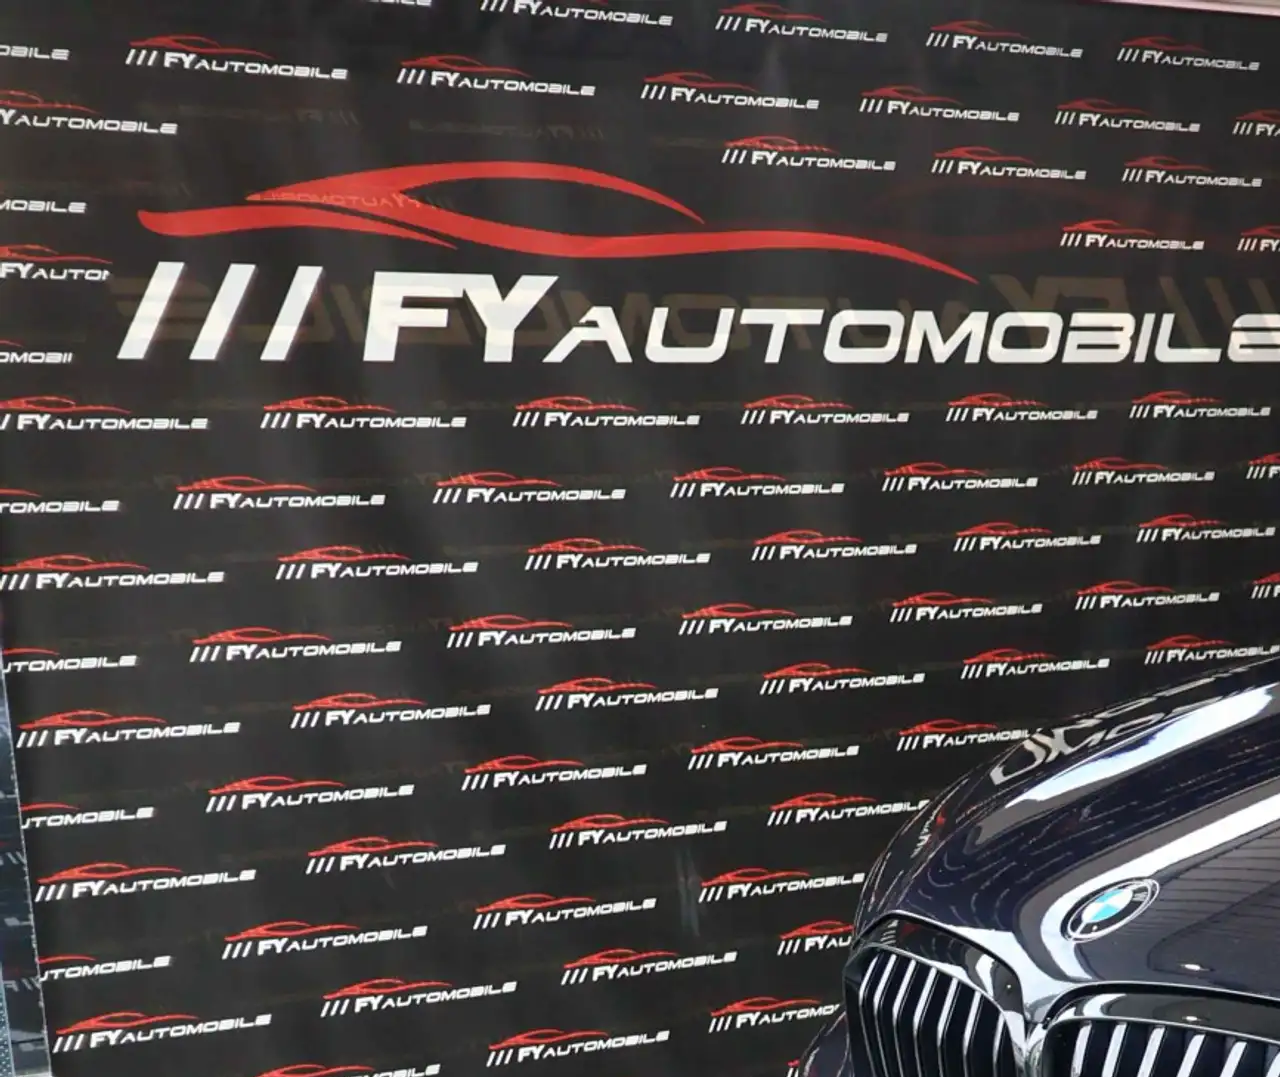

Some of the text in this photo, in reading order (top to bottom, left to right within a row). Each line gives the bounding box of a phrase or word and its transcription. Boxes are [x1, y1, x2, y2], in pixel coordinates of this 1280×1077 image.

[746, 18, 887, 42] FYAUTOMOBILE
[952, 35, 1082, 57] FYAUTOMOBILE
[164, 52, 347, 79] FYAUTOMOBILE
[1142, 50, 1259, 70] FYAUTOMOBILE
[431, 72, 595, 96] FYAUTOMOBILE
[671, 88, 819, 109] FYAUTOMOBILE
[888, 101, 1019, 121] FYAUTOMOBILE
[1079, 114, 1200, 132] FYAUTOMOBILE
[752, 151, 895, 170] FYAUTOMOBILE
[958, 161, 1086, 179] FYAUTOMOBILE
[1146, 170, 1262, 186] FYAUTOMOBILE
[1086, 234, 1204, 250] FYAUTOMOBILE
[545, 412, 699, 426] FYAUTOMOBILE
[770, 410, 908, 424] FYAUTOMOBILE
[972, 408, 1098, 421] FYAUTOMOBILE
[1154, 405, 1270, 418] FYAUTOMOBILE
[18, 414, 208, 430] FYAUTOMOBILE
[296, 414, 466, 428] FYAUTOMOBILE
[908, 477, 1038, 490] FYAUTOMOBILE
[1095, 472, 1214, 484] FYAUTOMOBILE
[467, 488, 625, 502] FYAUTOMOBILE
[700, 483, 844, 496] FYAUTOMOBILE
[210, 494, 385, 508] FYAUTOMOBILE
[980, 536, 1100, 550] FYAUTOMOBILE
[1162, 527, 1275, 541] FYAUTOMOBILE
[780, 544, 916, 559] FYAUTOMOBILE
[311, 562, 478, 578] FYAUTOMOBILE
[557, 554, 710, 568] FYAUTOMOBILE
[36, 572, 224, 588] FYAUTOMOBILE
[1100, 593, 1219, 608] FYAUTOMOBILE
[916, 604, 1042, 620] FYAUTOMOBILE
[709, 616, 852, 633] FYAUTOMOBILE
[478, 628, 636, 646] FYAUTOMOBILE
[226, 642, 401, 660] FYAUTOMOBILE
[1167, 645, 1280, 662] FYAUTOMOBILE
[986, 659, 1110, 676] FYAUTOMOBILE
[789, 674, 924, 692] FYAUTOMOBILE
[568, 688, 718, 708] FYAUTOMOBILE
[326, 705, 490, 726] FYAUTOMOBILE
[55, 722, 240, 745] FYAUTOMOBILE
[718, 746, 859, 767] FYAUTOMOBILE
[494, 764, 646, 787] FYAUTOMOBILE
[242, 785, 414, 809] FYAUTOMOBILE
[578, 821, 727, 845] FYAUTOMOBILE
[340, 845, 506, 870] FYAUTOMOBILE
[72, 870, 256, 898] FYAUTOMOBILE
[728, 873, 865, 899] FYAUTOMOBILE
[506, 898, 656, 926] FYAUTOMOBILE
[258, 926, 427, 955] FYAUTOMOBILE
[593, 952, 736, 981] FYAUTOMOBILE
[355, 982, 516, 1012] FYAUTOMOBILE
[90, 1014, 271, 1048] FYAUTOMOBILE
[518, 1031, 669, 1062] FYAUTOMOBILE
